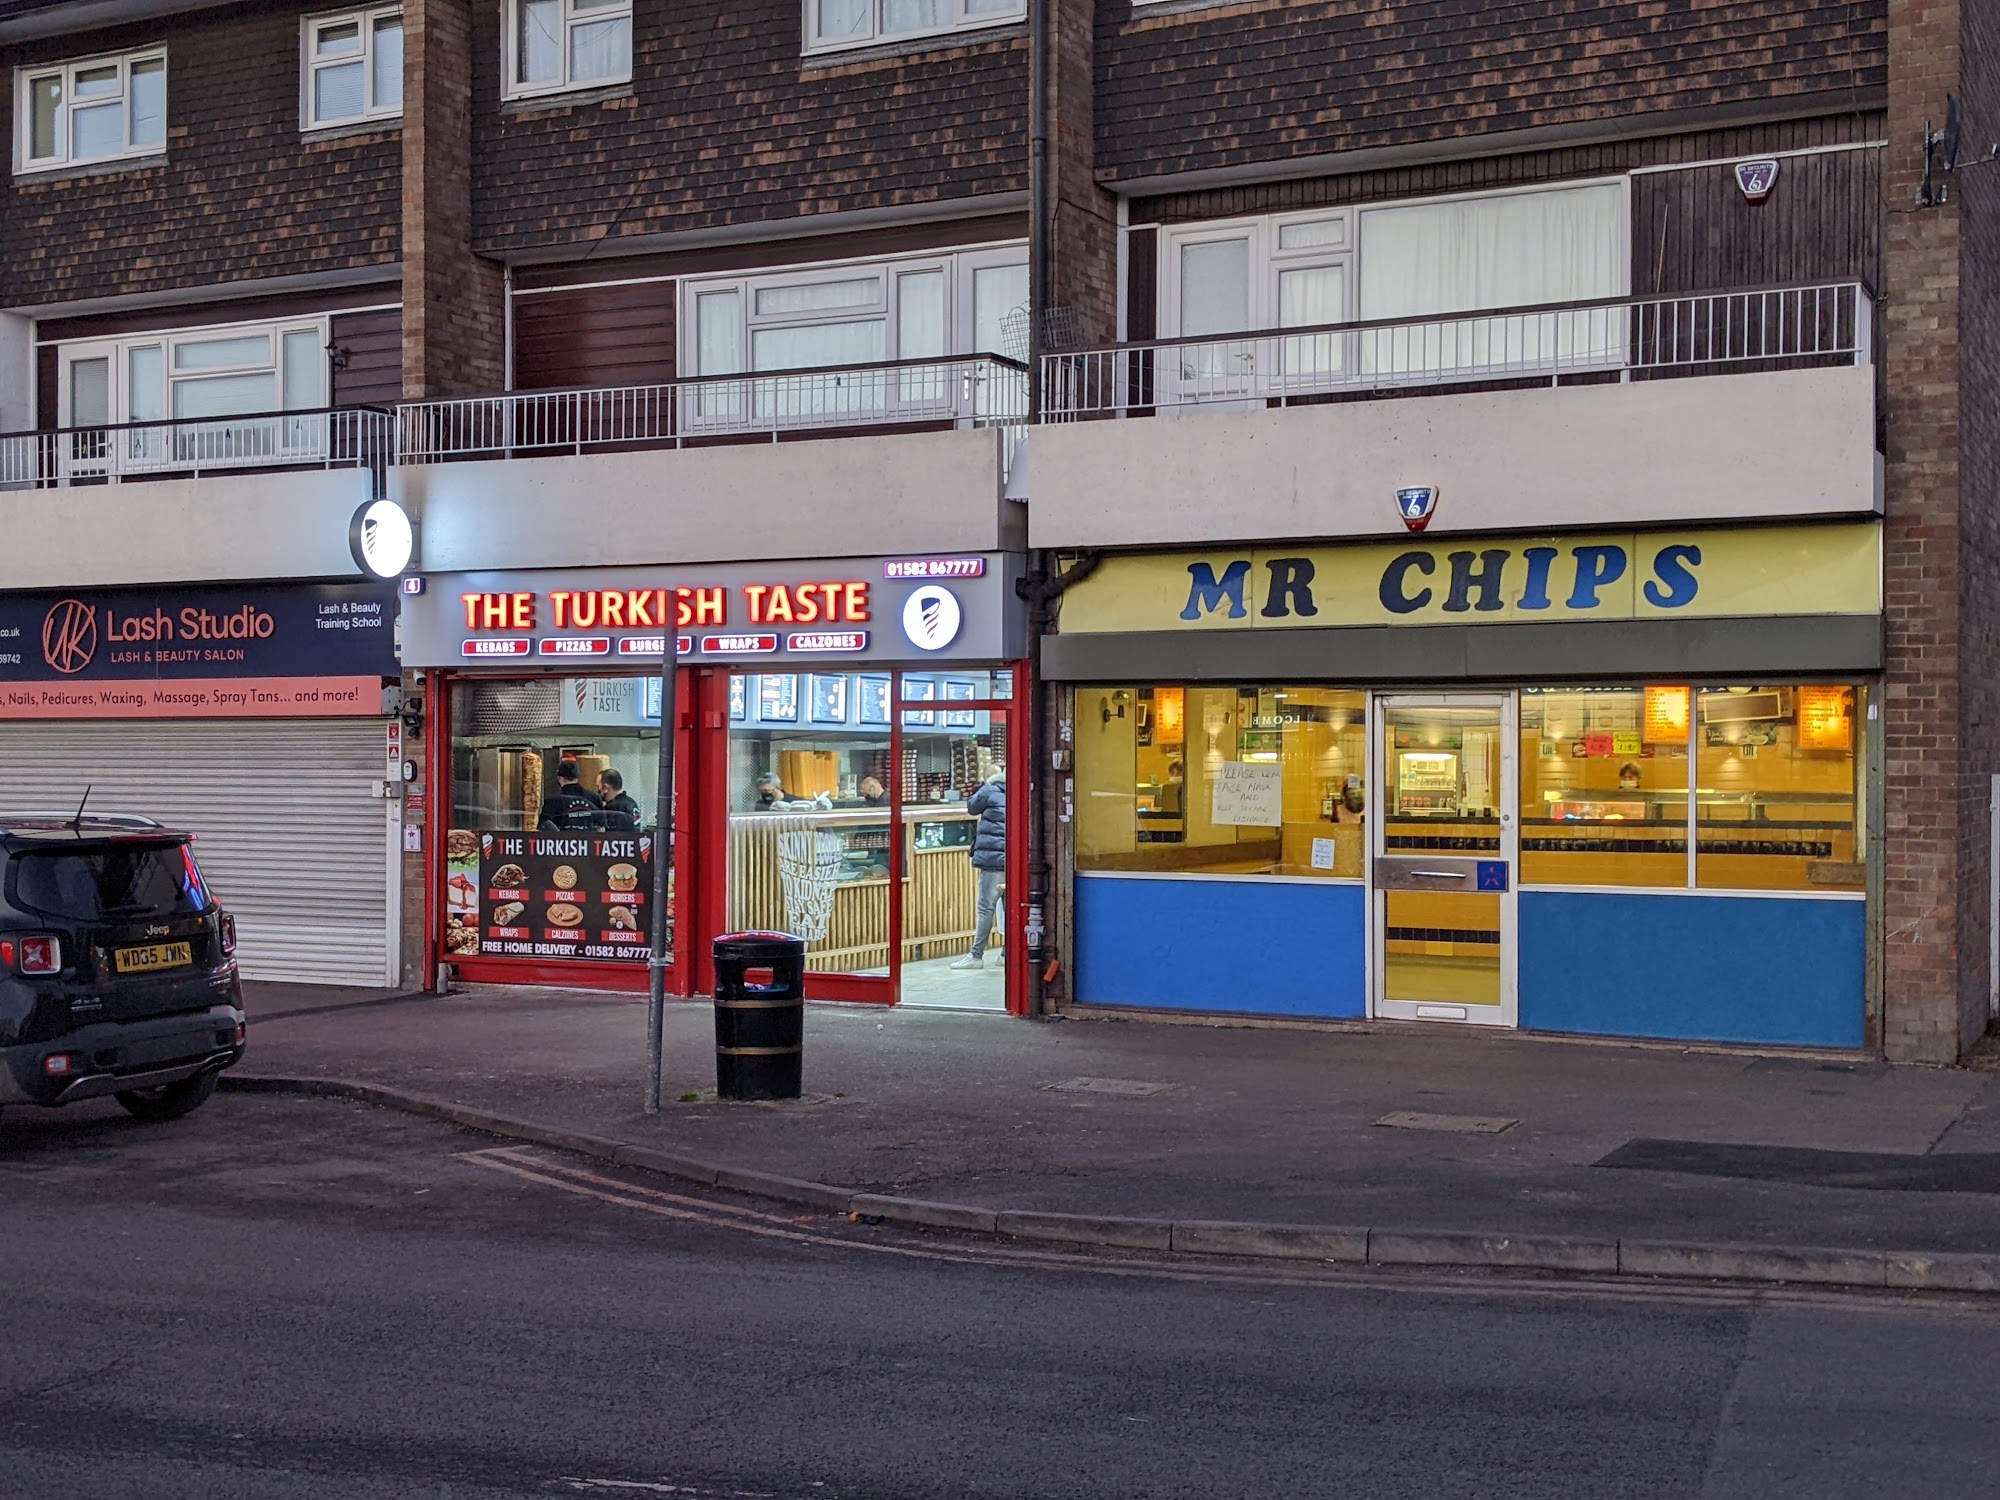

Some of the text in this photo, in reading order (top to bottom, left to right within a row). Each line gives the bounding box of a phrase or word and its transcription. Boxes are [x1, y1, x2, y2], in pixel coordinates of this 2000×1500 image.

[887, 560, 978, 576] 01582 867777
[408, 580, 417, 592] 4
[1180, 544, 1702, 620] MR CHIPS
[318, 602, 381, 615] Lash & Beauty
[462, 581, 869, 630] THE TURKISH TASTE
[107, 604, 275, 641] Lash Studio
[315, 616, 382, 631] Training School
[475, 641, 516, 653] KEBABS
[555, 640, 593, 652] PIZZAS
[629, 639, 681, 652] BURGE
[718, 637, 760, 650] WRAPS
[795, 635, 856, 649] CALZONES
[111, 649, 244, 663] LASH & BEAUTY SALON
[593, 681, 635, 697] TURKISH
[9, 692, 39, 706] Nails,
[42, 691, 97, 706] Pedicures,
[100, 691, 147, 708] Waxing,
[153, 690, 210, 707] Massage,
[213, 689, 247, 706] Spray
[295, 687, 319, 702] and
[323, 686, 359, 702] more!
[593, 697, 621, 712] TASTE
[1220, 767, 1255, 779] PLEASE
[1216, 782, 1271, 793] FACE MASK
[498, 838, 635, 858] THE TURKISH TASTE
[799, 862, 841, 881] EASIER
[498, 889, 520, 900] KEBABS
[555, 891, 575, 901] PIZZAS
[610, 893, 636, 903] BURGERS
[807, 898, 833, 915] SAFE
[788, 911, 831, 930] EAT
[147, 925, 170, 936] Jeep
[499, 928, 518, 938] WRAPS
[551, 930, 579, 940] CALZONES
[608, 932, 637, 942] DESSERTS
[161, 944, 187, 963] JWN
[482, 941, 503, 952] FREE
[504, 942, 533, 954] HOME
[535, 943, 577, 956] DELIVERY
[585, 945, 614, 957] 01582
[616, 946, 652, 959] 867777
